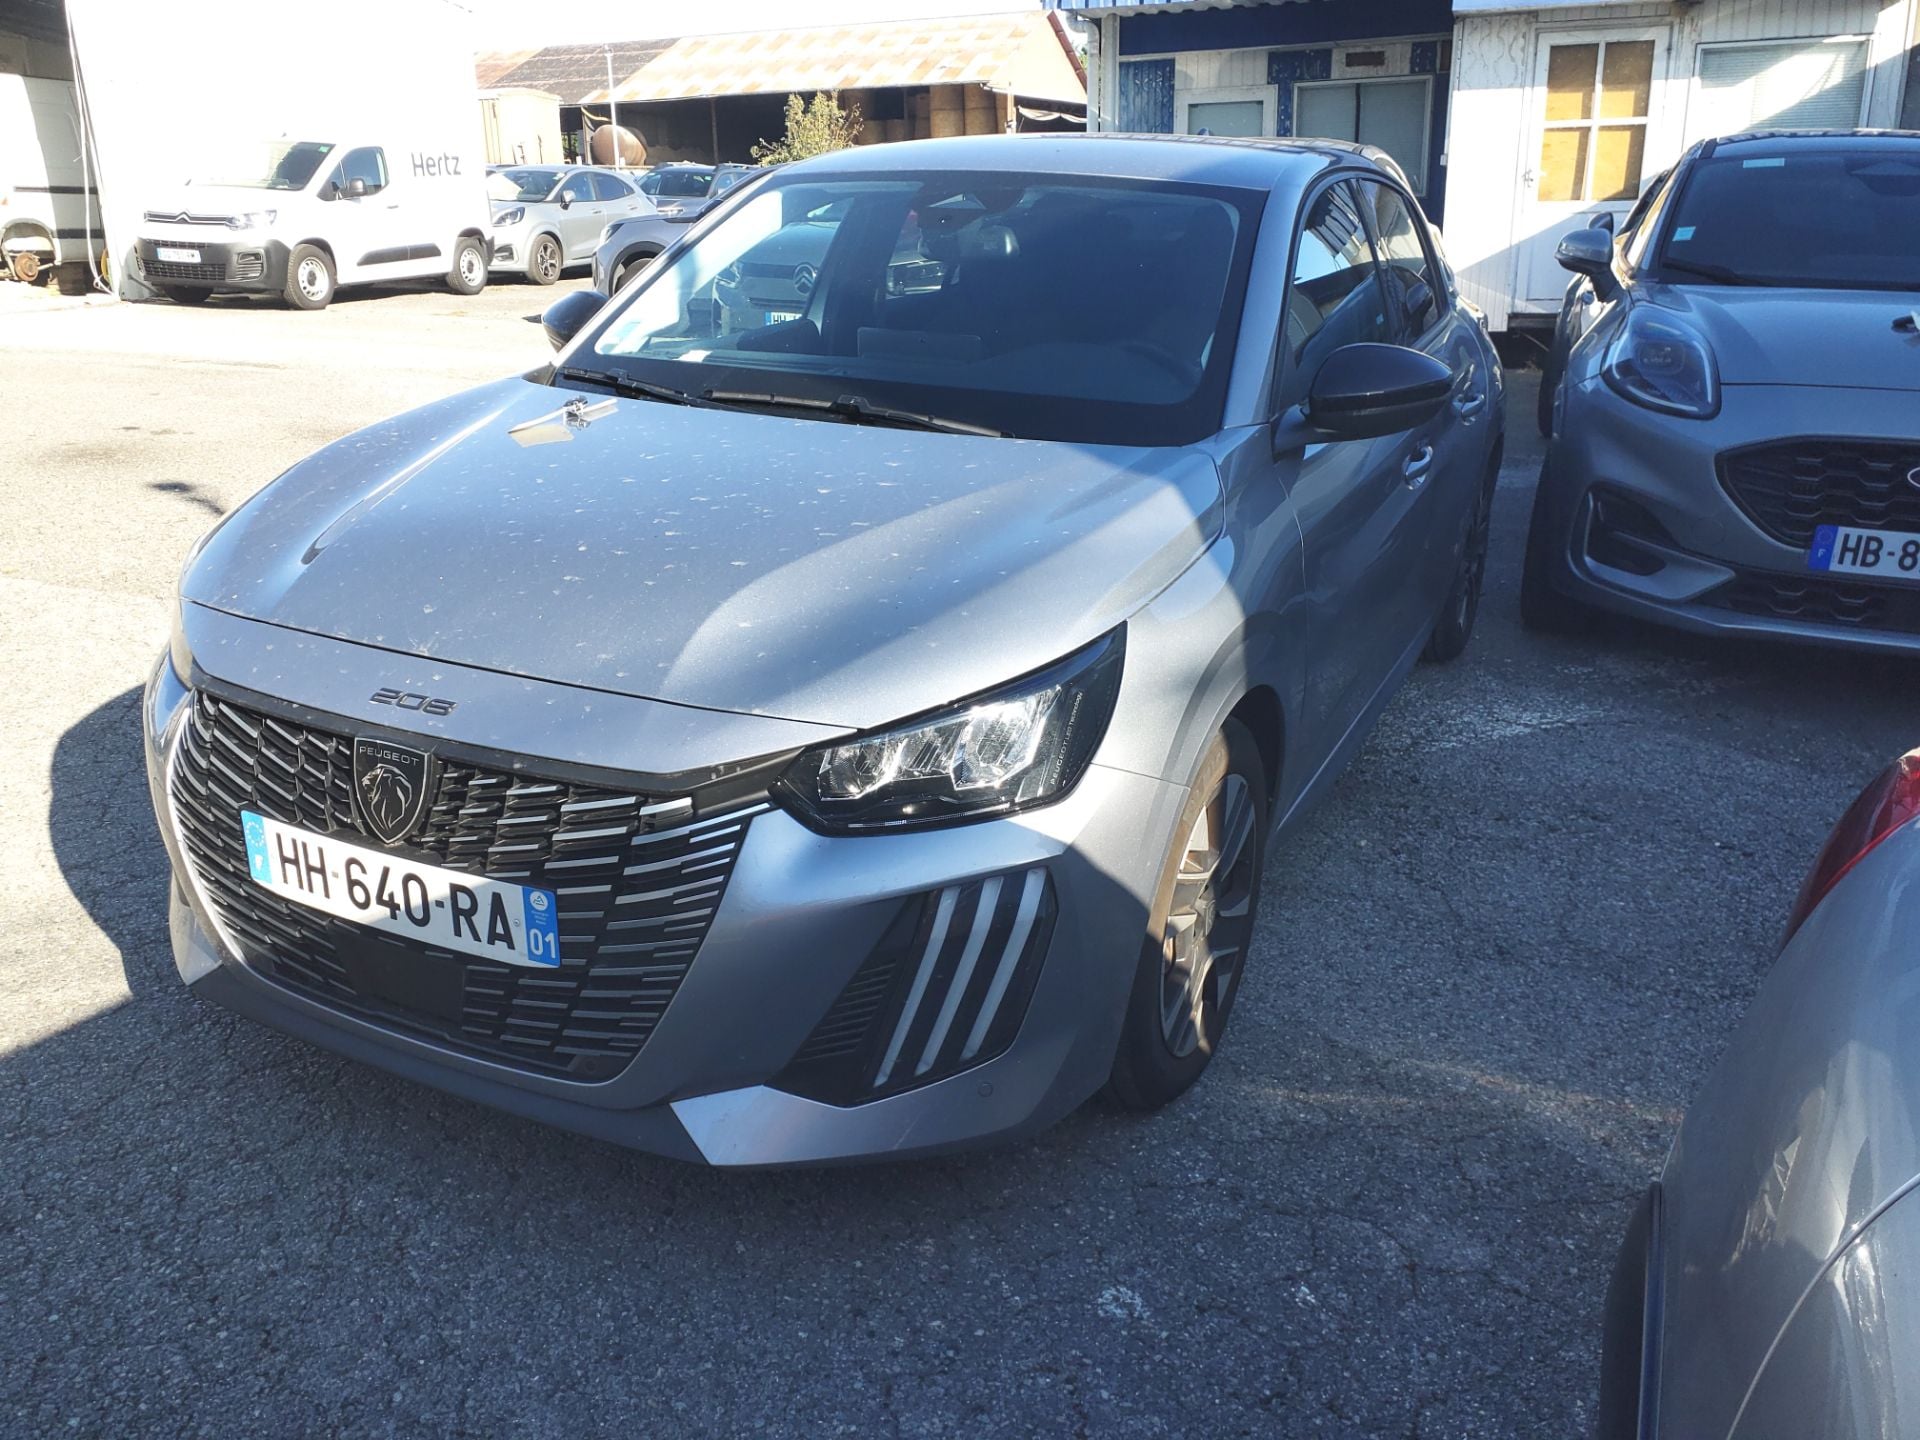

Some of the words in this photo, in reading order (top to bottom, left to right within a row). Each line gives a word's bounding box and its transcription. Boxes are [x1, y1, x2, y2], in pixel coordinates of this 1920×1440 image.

[411, 151, 462, 177] Hertz
[1837, 533, 1920, 572] HB-8
[368, 687, 457, 716] 208
[359, 746, 420, 766] PEUGEOT
[1050, 741, 1067, 785] PEUGEOT
[276, 833, 516, 951] HH-640-RA
[529, 928, 556, 959] 01
